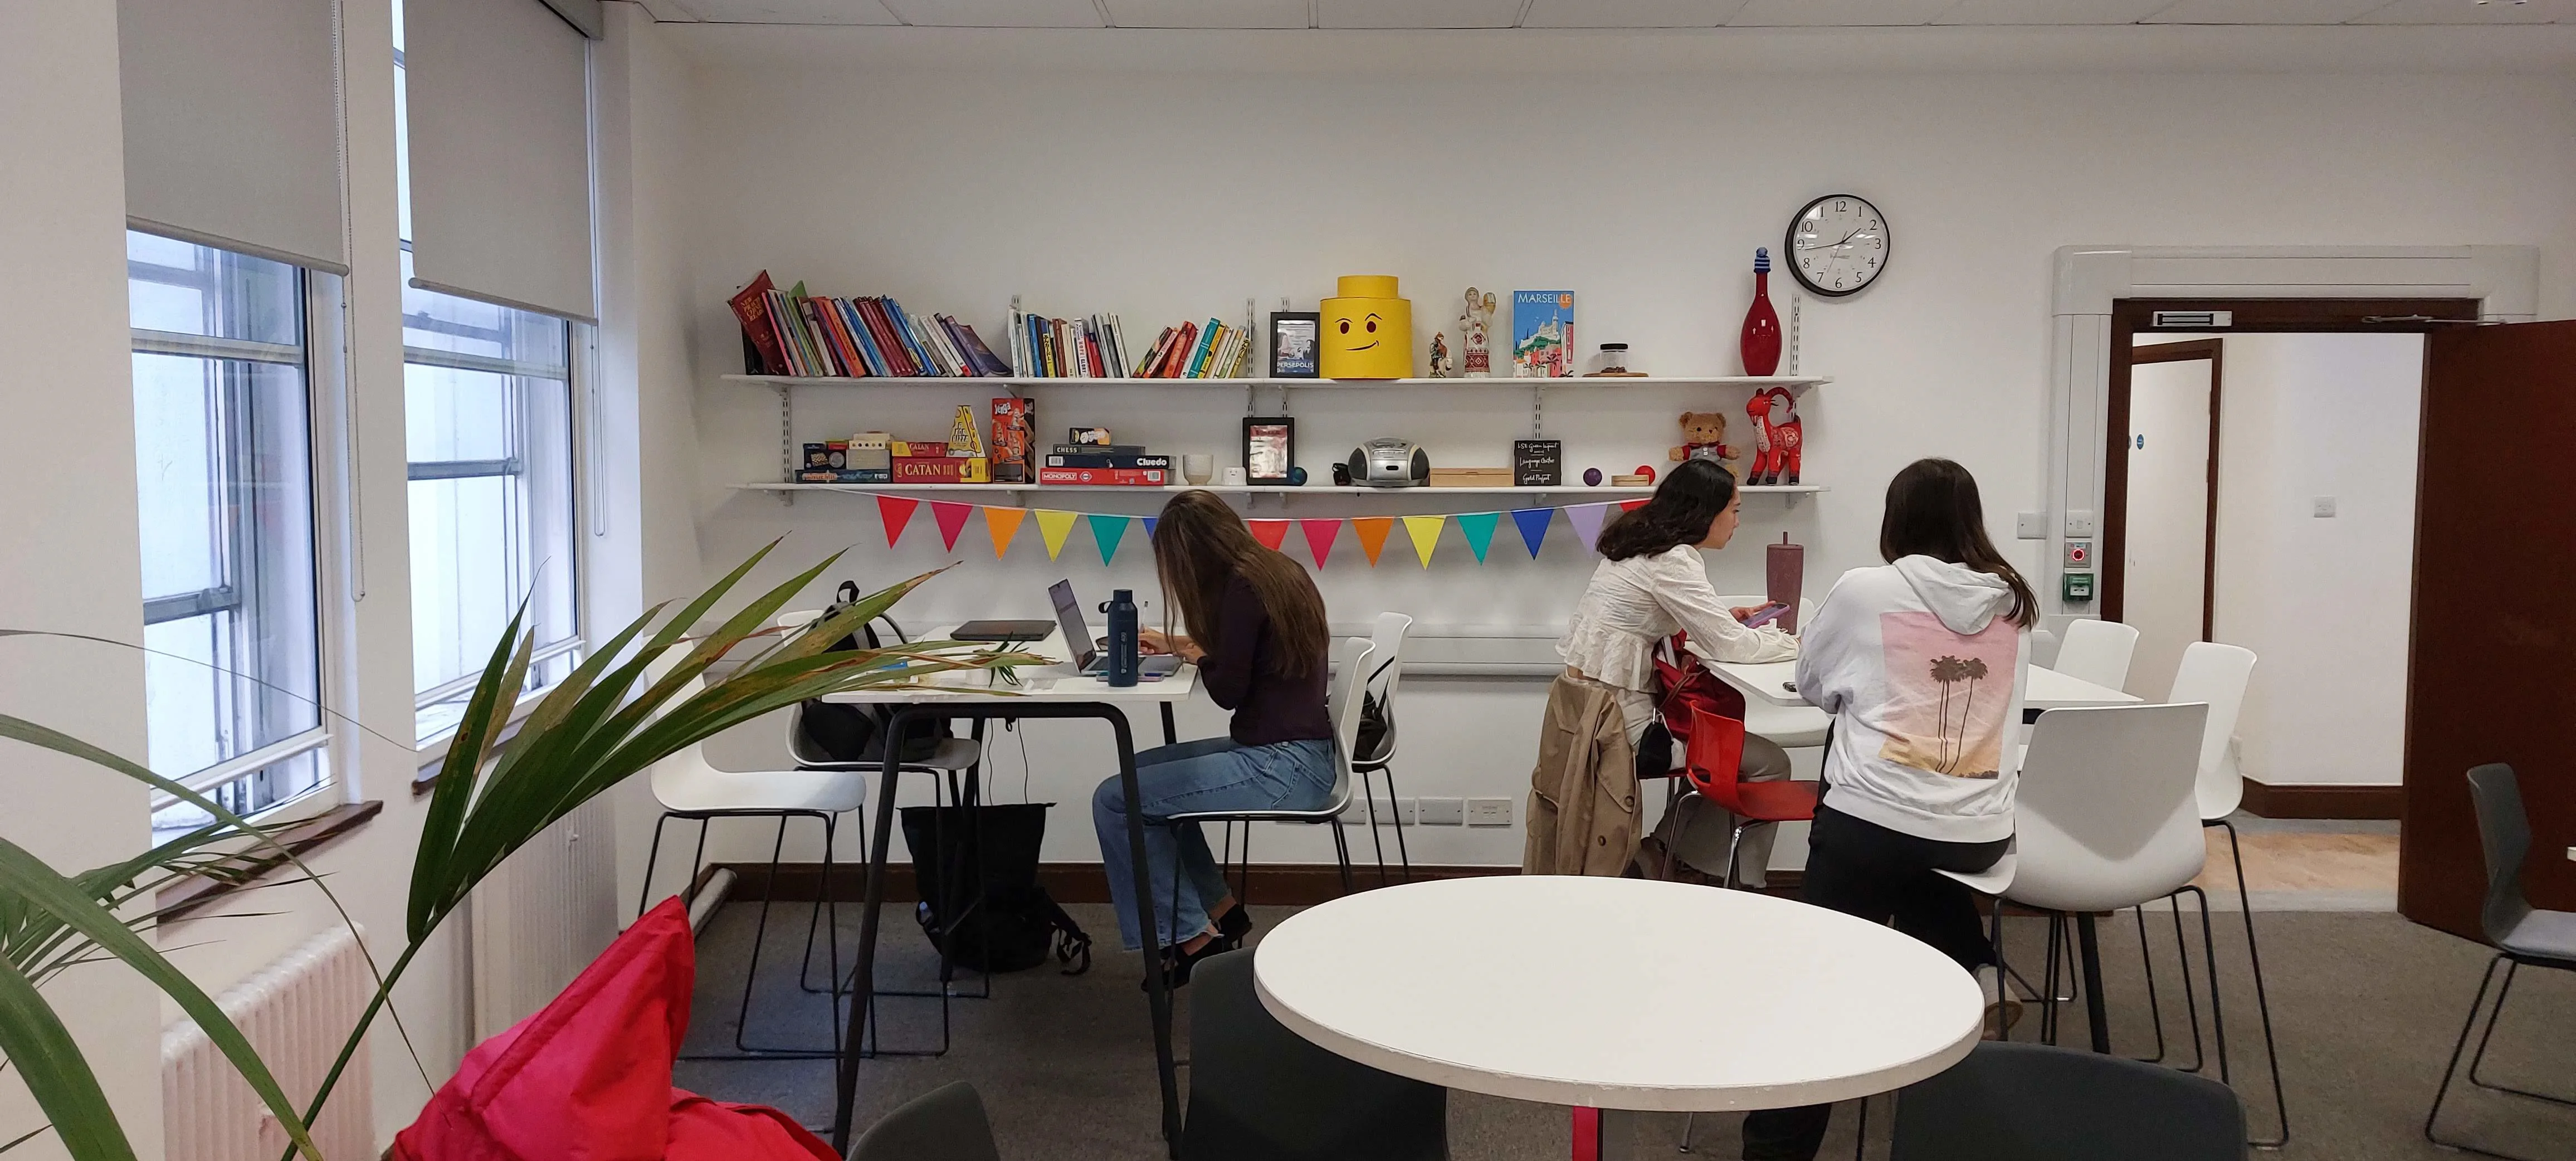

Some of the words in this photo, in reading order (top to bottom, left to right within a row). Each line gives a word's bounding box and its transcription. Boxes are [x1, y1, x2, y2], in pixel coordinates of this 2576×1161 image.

[1835, 201, 1847, 212] 12
[1858, 206, 1862, 217] 1
[1801, 221, 1813, 232] 10
[1870, 219, 1877, 230] 2
[1797, 239, 1804, 250] 9
[1875, 238, 1881, 249] 3
[1803, 258, 1810, 269] 8
[1867, 257, 1876, 267] 4
[1817, 272, 1824, 282] 7
[1835, 277, 1842, 288] 6
[1855, 272, 1862, 282] 5
[1518, 293, 1570, 303] MARSEILLE
[994, 402, 1011, 414] Jenga
[1137, 457, 1167, 466] Cluedo
[905, 464, 940, 475] CATAN
